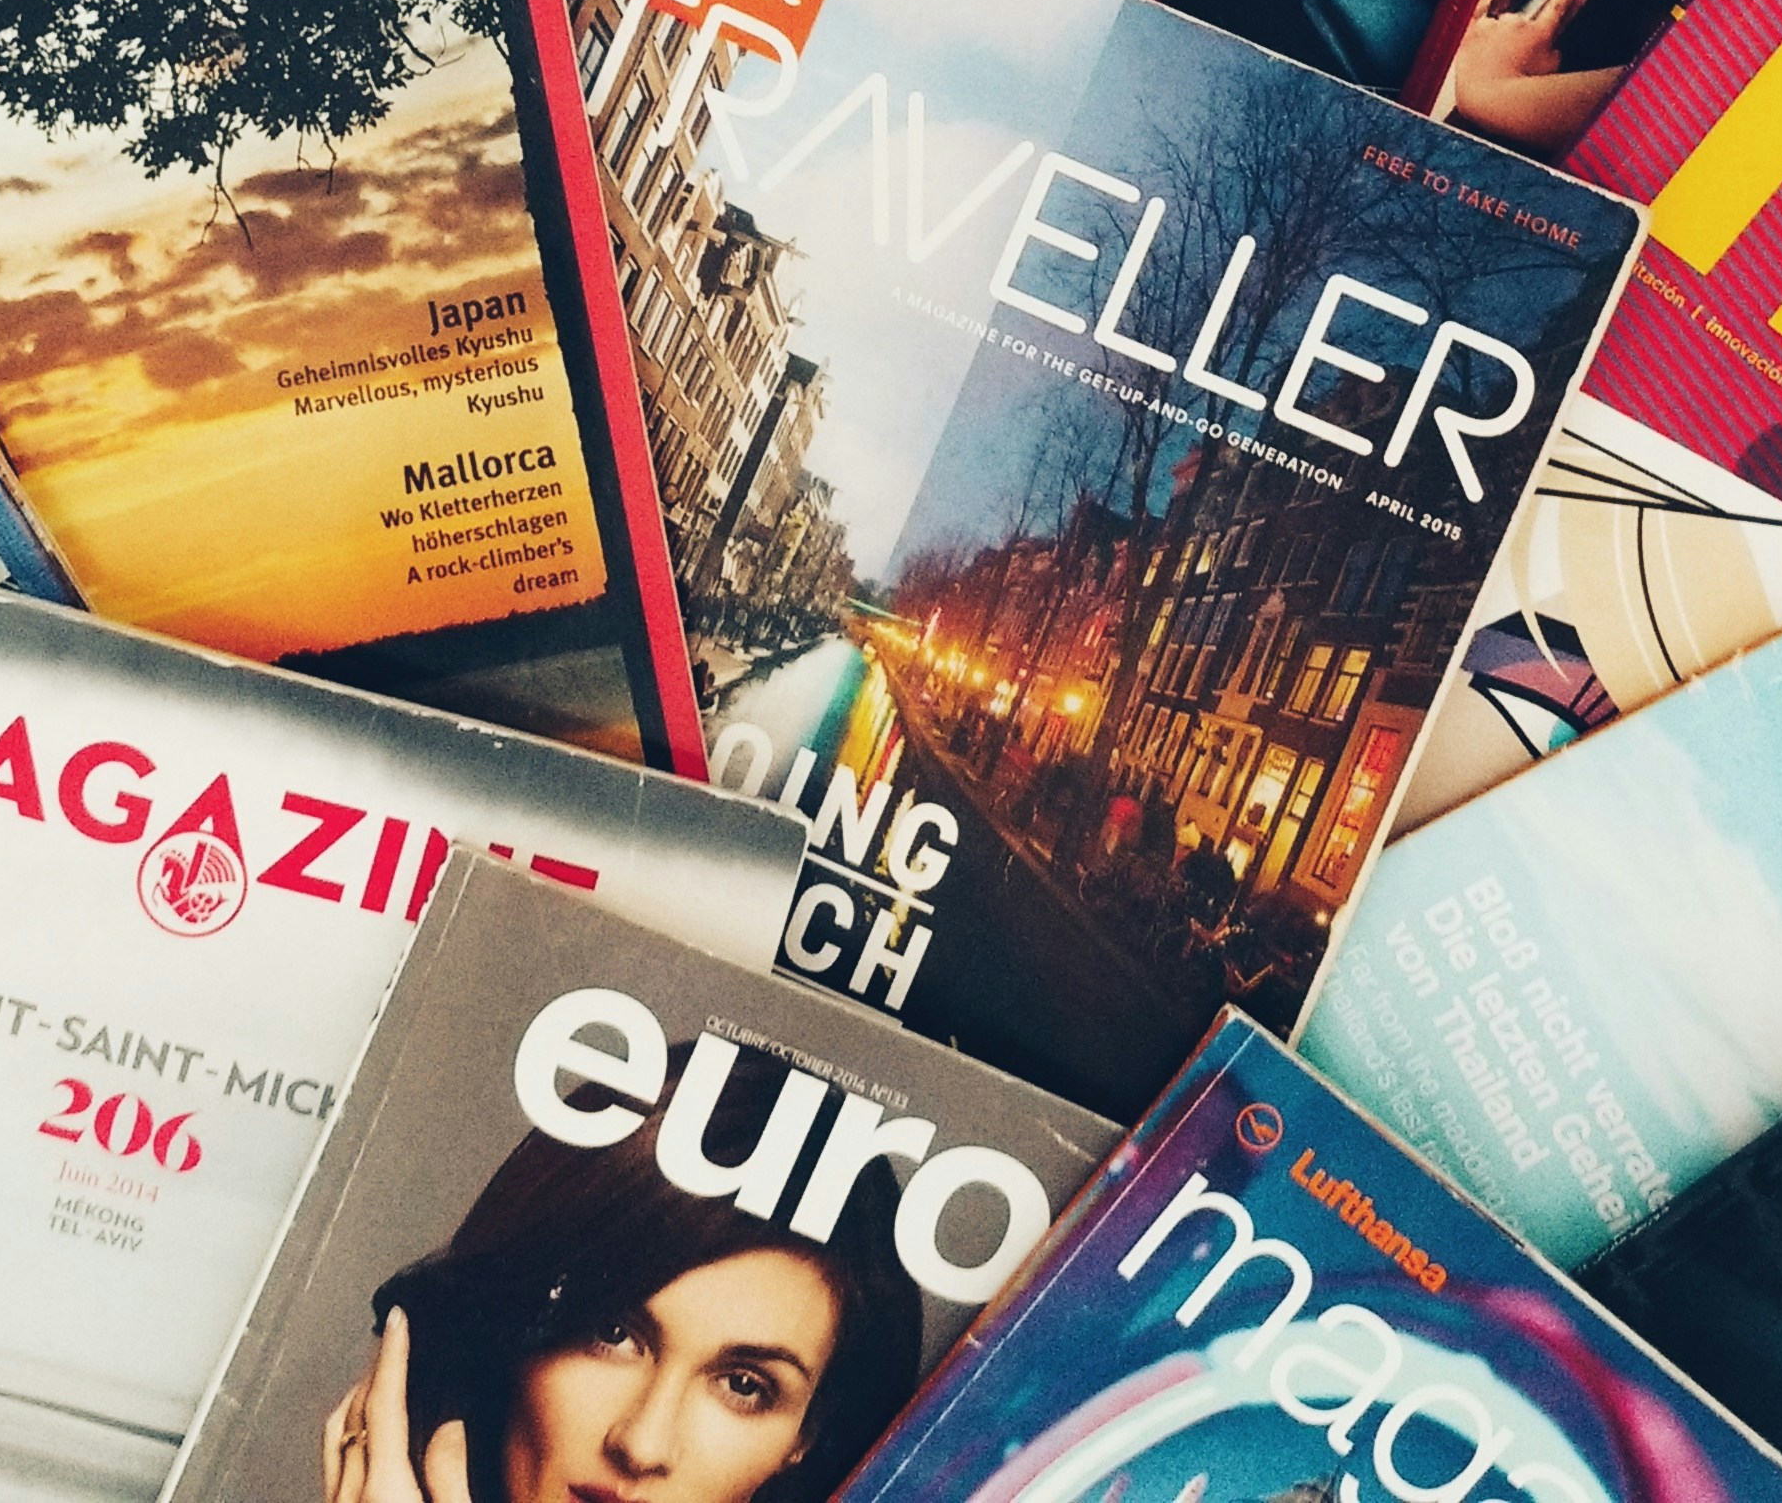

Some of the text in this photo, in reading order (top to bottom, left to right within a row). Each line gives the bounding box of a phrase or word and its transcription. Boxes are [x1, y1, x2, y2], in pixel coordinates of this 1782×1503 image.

[1361, 142, 1583, 252] FREE TO TAKE HOME
[428, 292, 527, 337] Japan
[277, 326, 533, 390] Geheimnisvolles Kyushu
[294, 357, 540, 417] Marvellous, mysterious
[467, 384, 544, 416] Kyushu
[907, 295, 1344, 491] MAGAZINE FOR THE GET-UP-AND-GO GENERATION
[403, 445, 557, 496] Mallorca
[380, 481, 563, 529] Wo Kletterherzen
[412, 510, 568, 554] höherschlagen
[1365, 490, 1462, 543] APRIL 2015
[407, 537, 575, 585] A rock-climber's
[513, 567, 579, 595] dream
[785, 885, 933, 1010] CH
[1424, 896, 1558, 1111] Die letzten
[1523, 977, 1599, 1078] nicht
[1386, 920, 1550, 1174] von Thailand
[38, 1077, 202, 1173] 206
[513, 988, 1051, 1302] euro
[58, 1159, 160, 1205] Juin 2014
[54, 1192, 145, 1233] MÉKONG
[1288, 1147, 1449, 1295] Lufthansa
